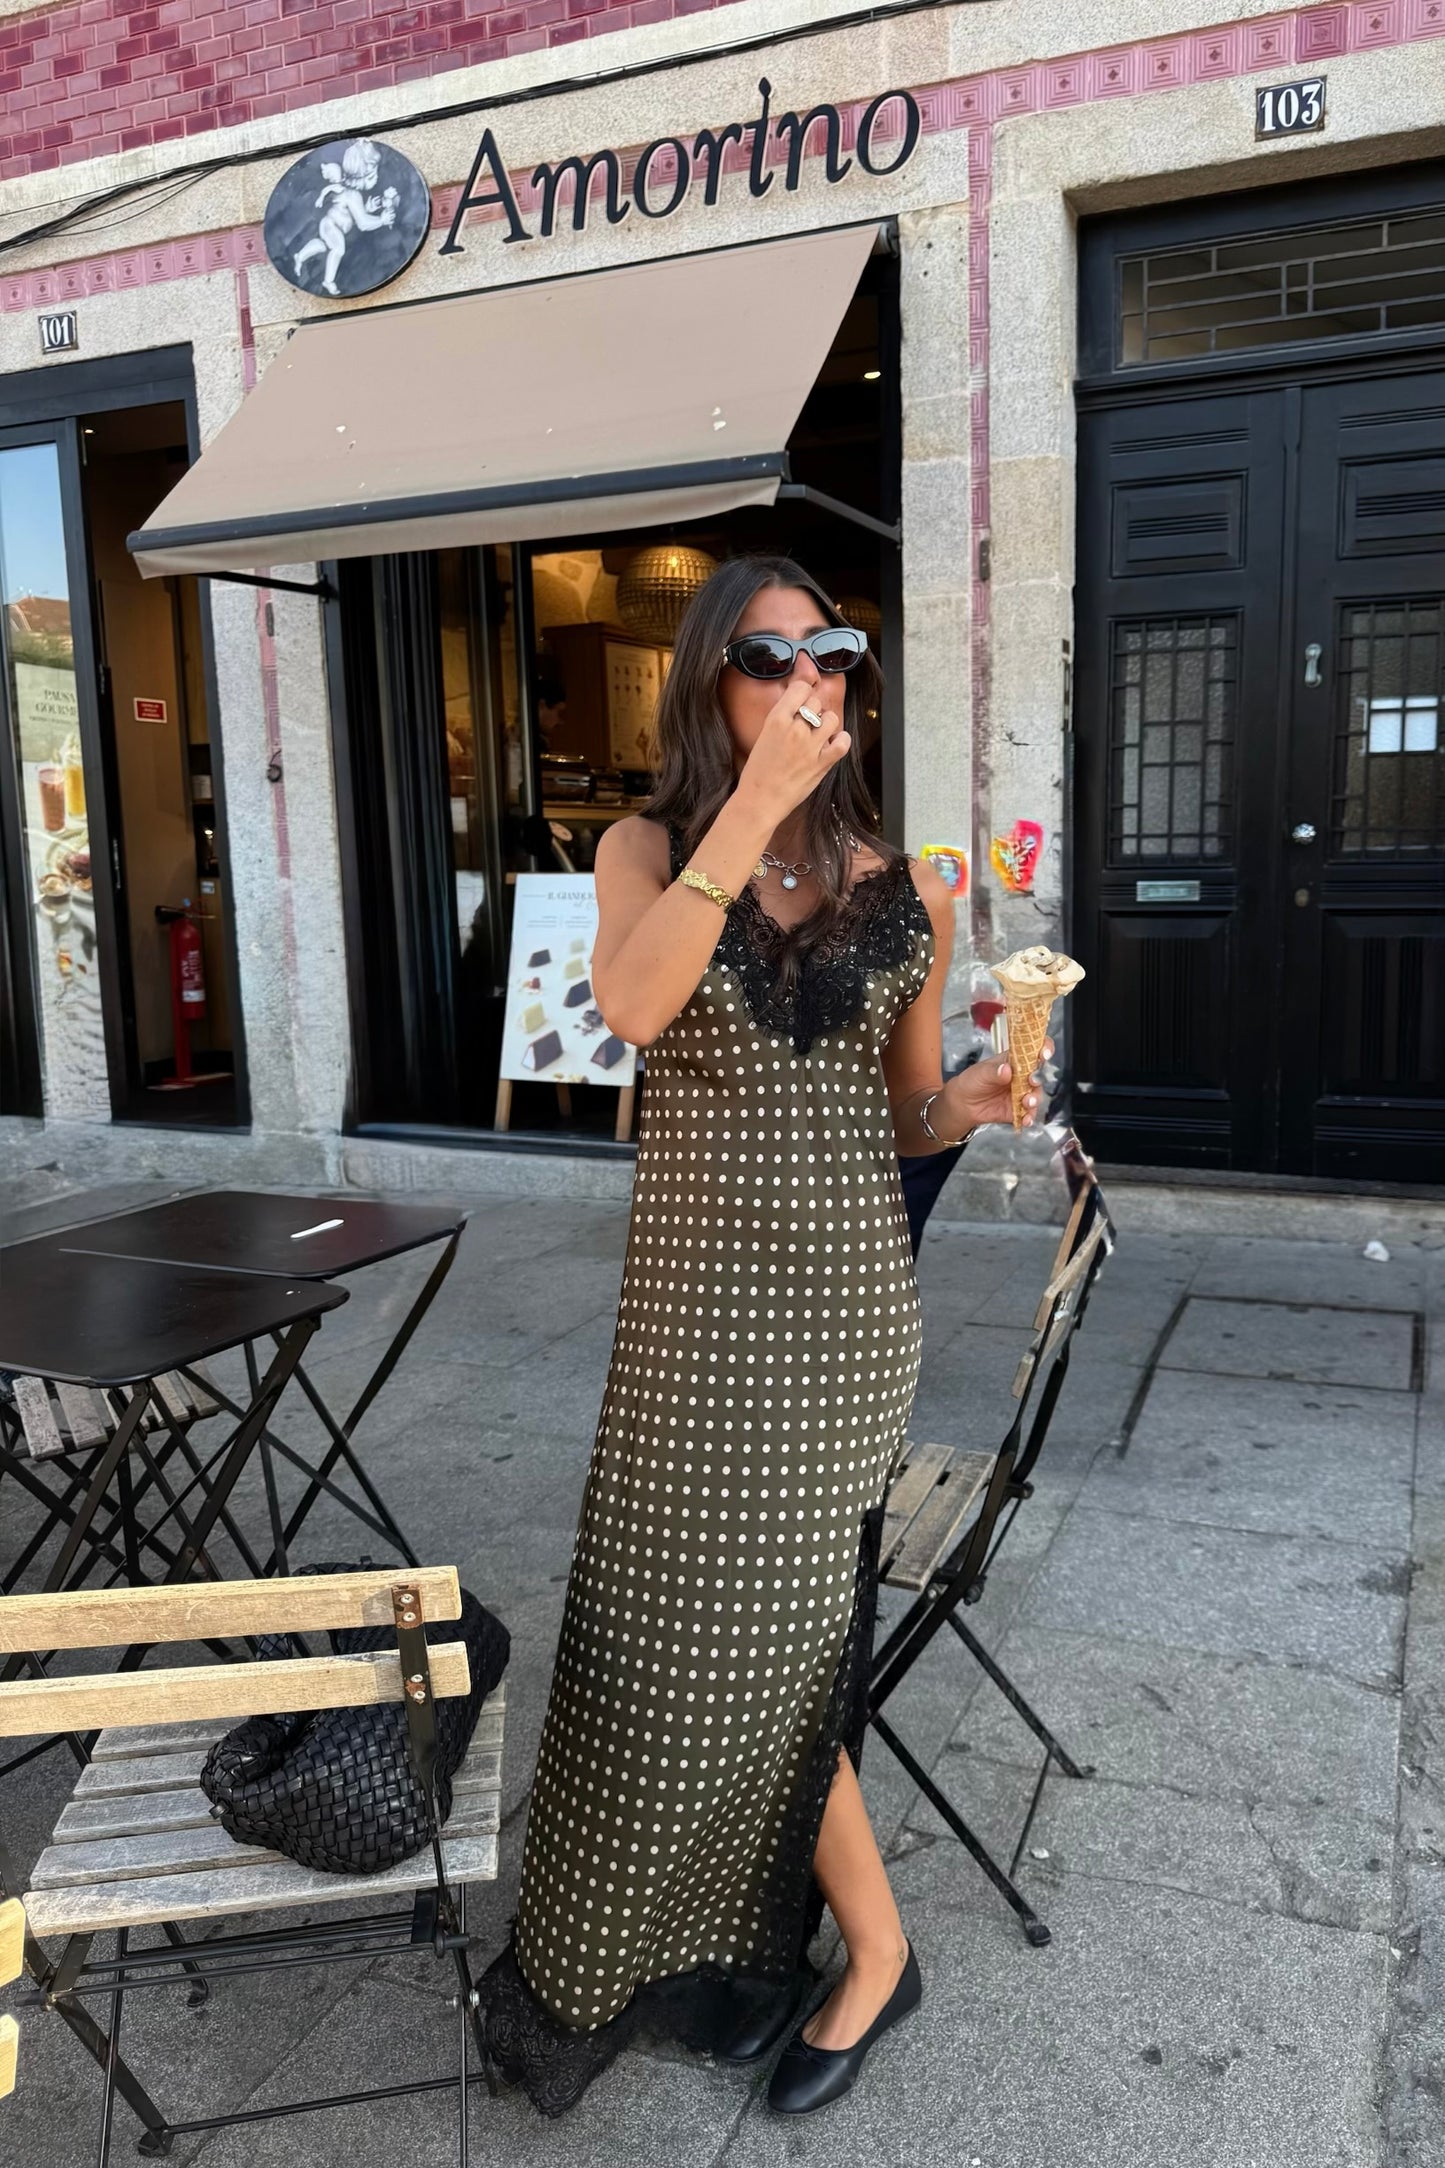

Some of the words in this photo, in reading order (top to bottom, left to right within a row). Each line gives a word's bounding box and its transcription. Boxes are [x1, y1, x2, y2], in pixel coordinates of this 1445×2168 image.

[1261, 84, 1321, 131] 103
[438, 78, 920, 255] Amorino
[42, 316, 70, 347] 101
